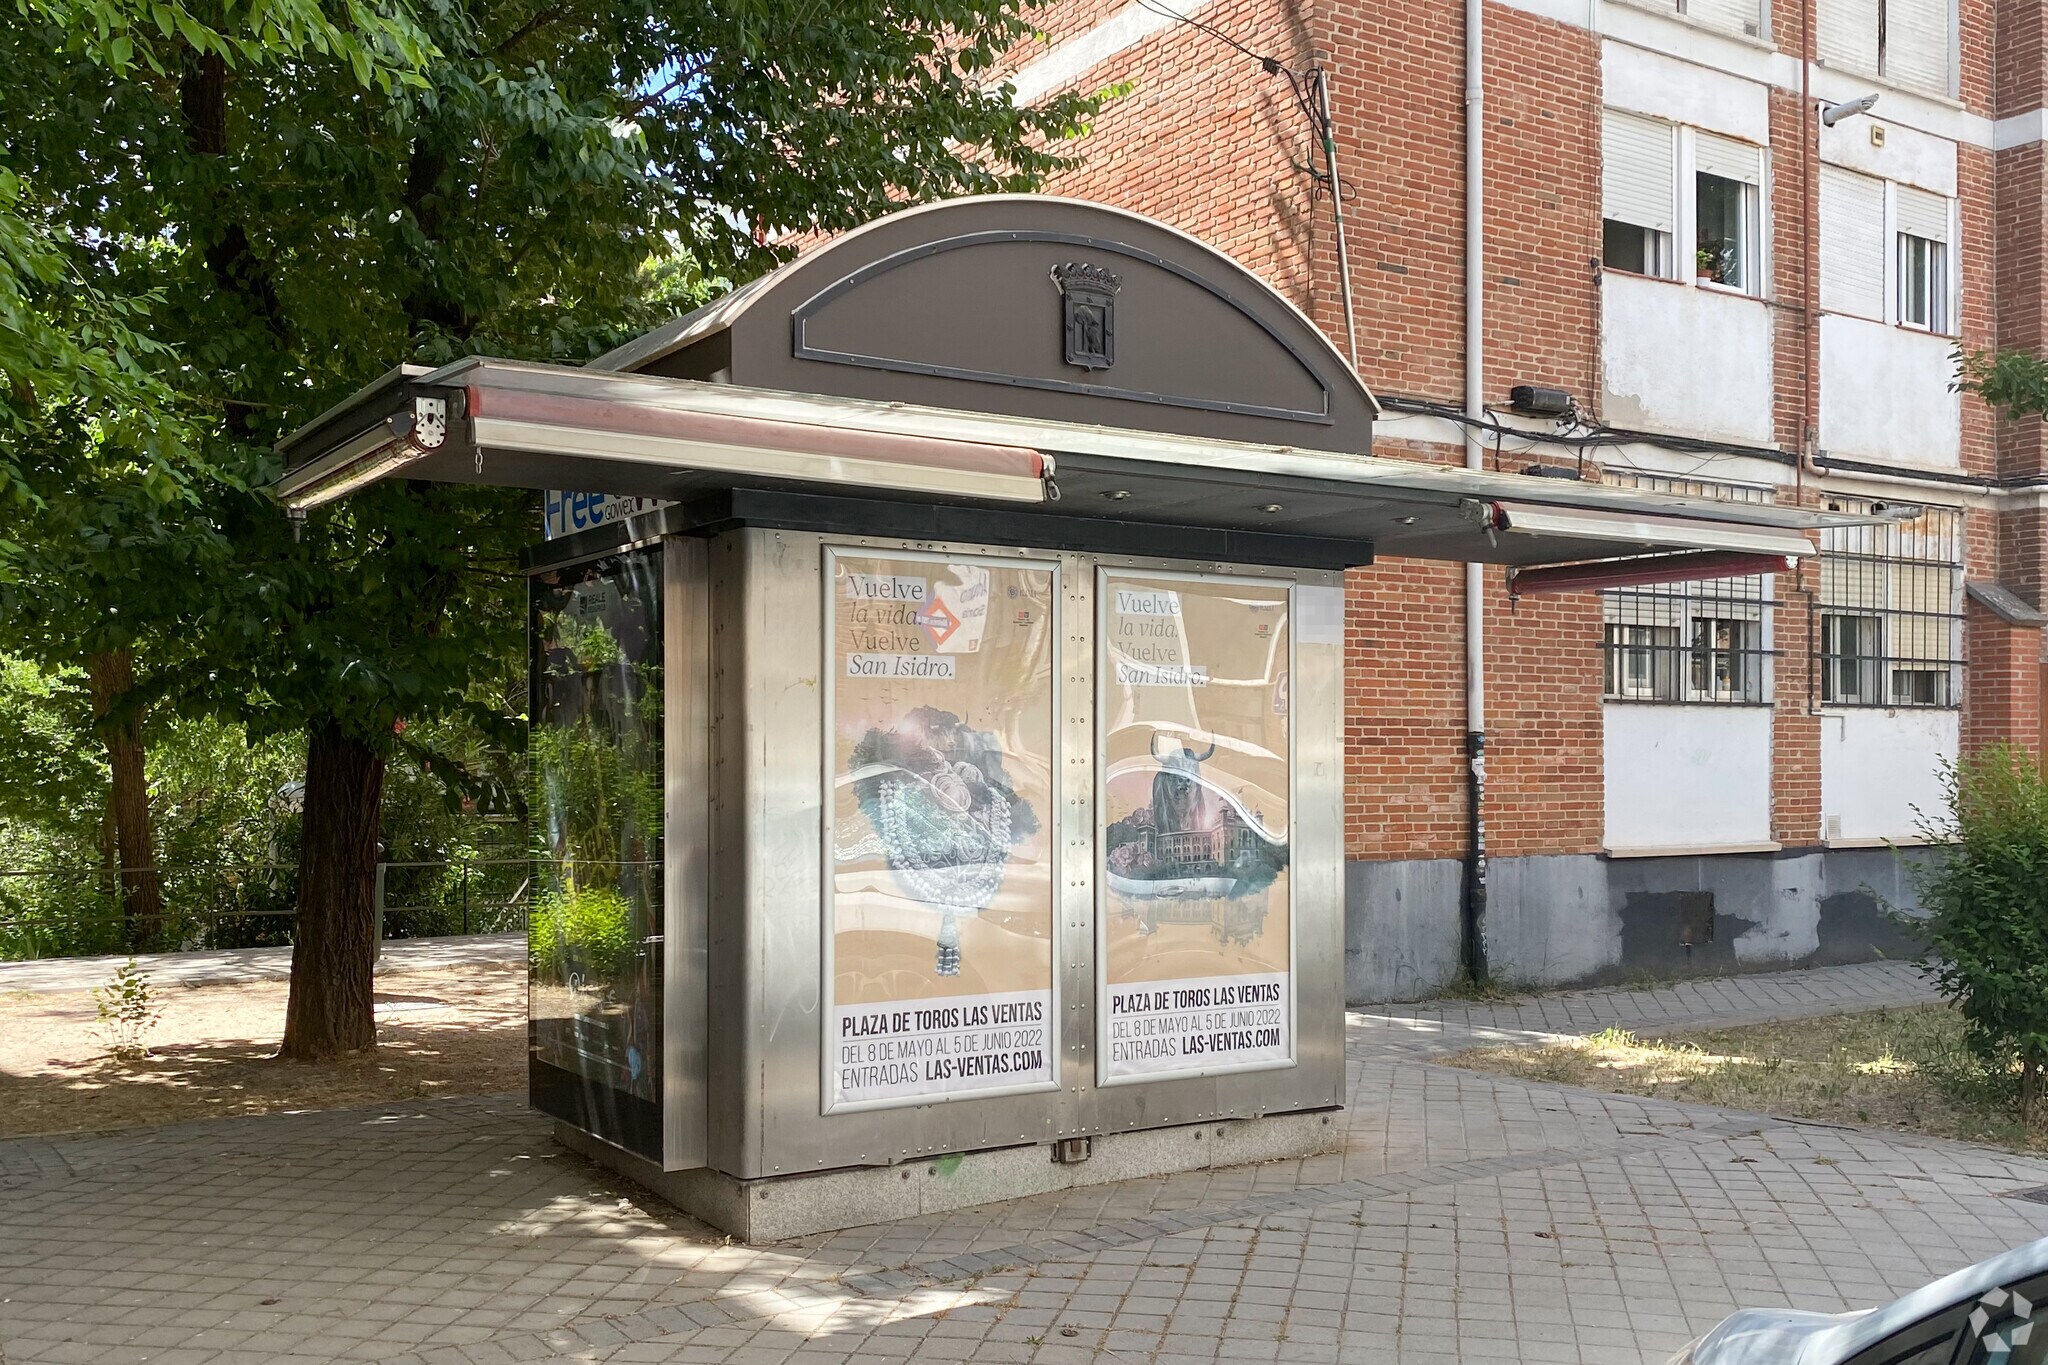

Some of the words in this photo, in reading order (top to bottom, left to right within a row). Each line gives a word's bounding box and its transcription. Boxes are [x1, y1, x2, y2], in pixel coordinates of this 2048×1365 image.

[849, 576, 923, 600] Vuelve
[850, 602, 867, 623] la
[877, 604, 922, 625] vida.
[1118, 593, 1179, 614] Vuelve
[1118, 616, 1133, 635] la
[1141, 619, 1179, 638] vida.
[850, 630, 920, 652] Vuelve
[1118, 642, 1176, 662] Vuelve
[849, 655, 887, 675] San
[893, 657, 953, 677] Isidro.
[1119, 665, 1150, 684] San
[1154, 666, 1204, 685] Isidro.
[1113, 993, 1151, 1014] PLAZA
[1154, 991, 1169, 1010] DE
[1173, 988, 1210, 1008] TOROS
[1214, 986, 1235, 1005] LAS
[1237, 983, 1280, 1003] VENTAS
[842, 1014, 888, 1037] PLAZA
[893, 1012, 910, 1032] DE
[914, 1008, 959, 1031] TOROS
[963, 1005, 988, 1027] LAS
[992, 1001, 1042, 1024] VENTAS
[1113, 1021, 1132, 1039] DEL
[1134, 1020, 1141, 1036] 8
[1144, 1018, 1156, 1036] DE
[1159, 1016, 1188, 1034] MAYO
[1191, 1014, 1203, 1031] AL
[1205, 1013, 1212, 1029] 5
[1214, 1012, 1226, 1029] DE
[1229, 1010, 1254, 1028] JUNIO
[1256, 1008, 1280, 1025] 2022
[842, 1045, 864, 1065] DEL
[868, 1043, 876, 1062] 8
[879, 1041, 894, 1060] DE
[897, 1038, 933, 1059] MAYO
[935, 1036, 950, 1055] AL
[954, 1035, 961, 1053] 5
[964, 1034, 978, 1052] DE
[982, 1031, 1011, 1051] JUNIO
[1014, 1029, 1043, 1048] 2022
[1113, 1037, 1176, 1061] ENTRADAS
[1182, 1028, 1280, 1055] LAS-VENTAS.COM
[842, 1061, 918, 1089] ENTRADAS
[925, 1050, 1042, 1081] LAS-VENTAS.COM
